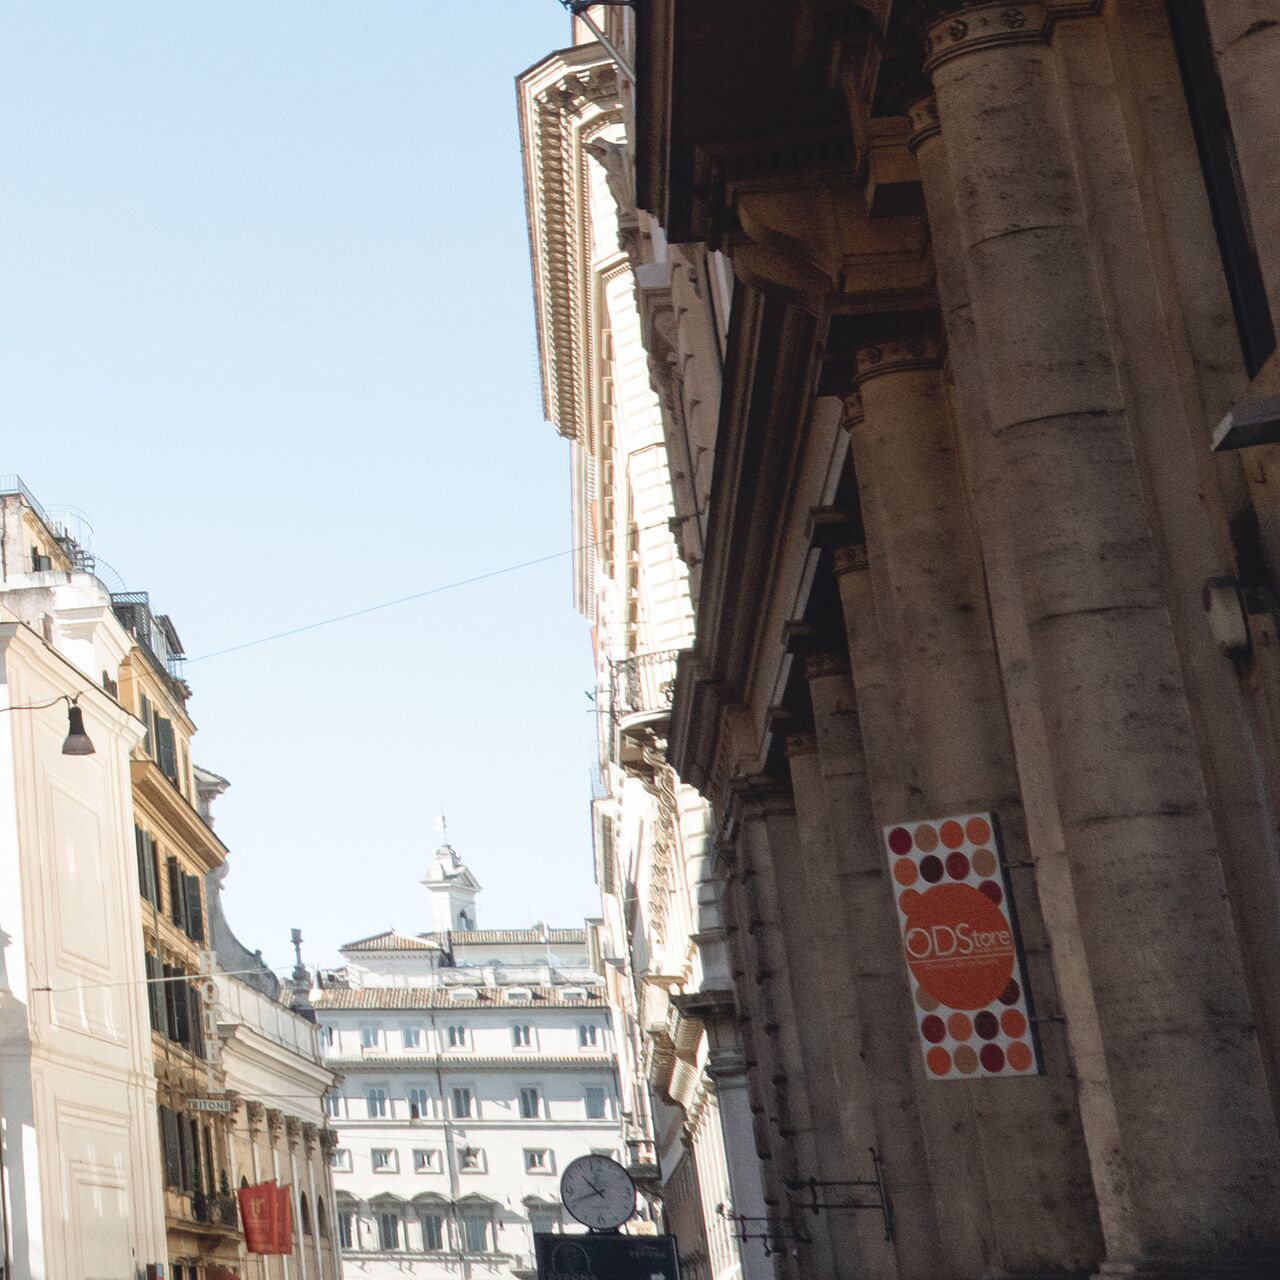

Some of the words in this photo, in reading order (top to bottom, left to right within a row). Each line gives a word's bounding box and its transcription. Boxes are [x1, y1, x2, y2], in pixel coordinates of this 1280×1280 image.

[905, 921, 1011, 959] ODStore
[199, 950, 226, 1094] HOTEL
[188, 1099, 231, 1112] TRITONE
